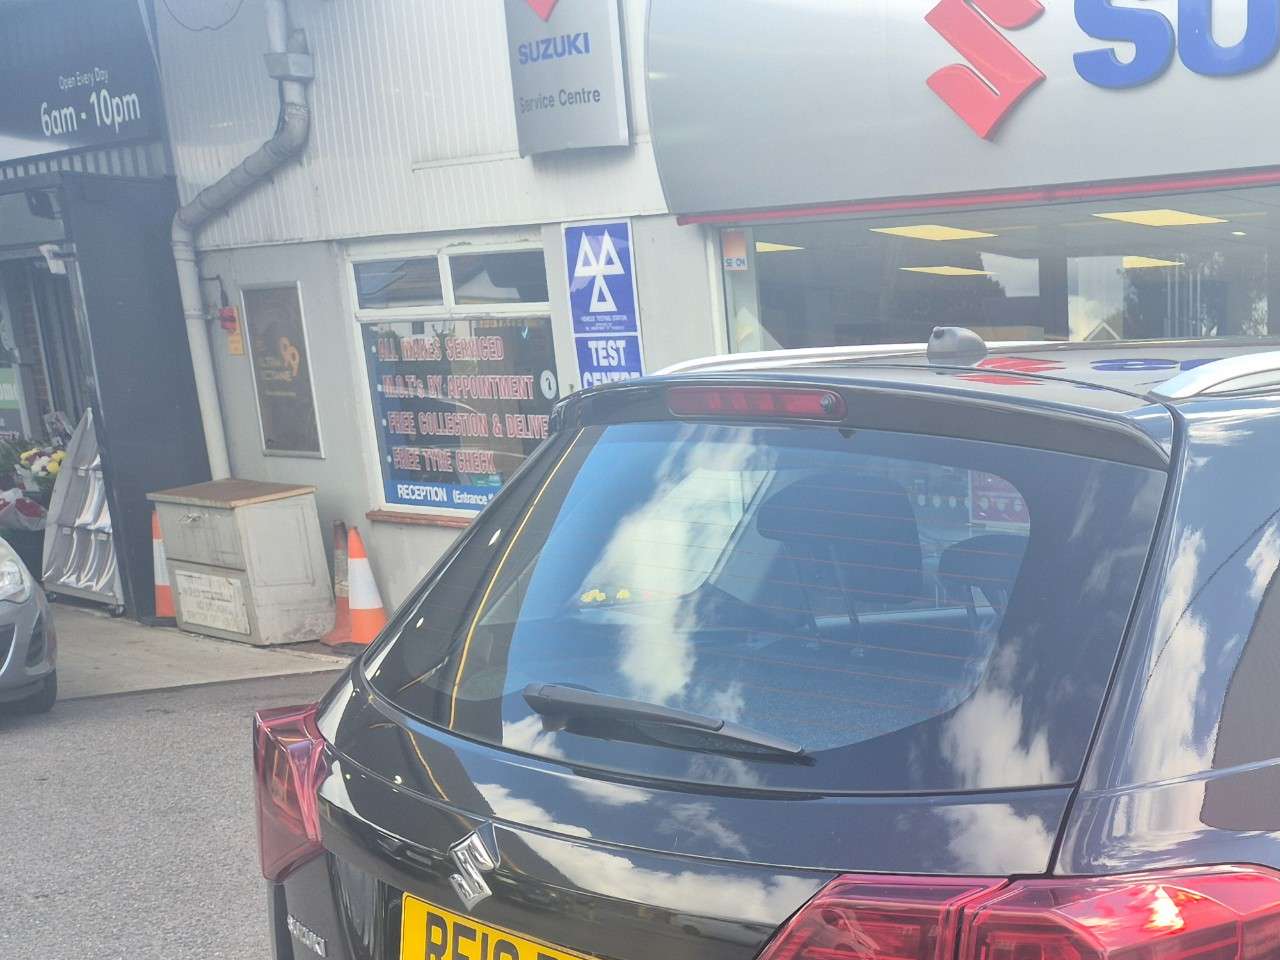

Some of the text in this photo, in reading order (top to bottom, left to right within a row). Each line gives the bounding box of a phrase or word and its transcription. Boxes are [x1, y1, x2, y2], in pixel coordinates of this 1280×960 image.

[518, 32, 590, 65] SUZUKI
[94, 67, 109, 83] Day
[41, 101, 77, 136] 6am
[90, 88, 141, 134] 10pm
[519, 87, 601, 114] Service Centre
[378, 336, 504, 361] ALL MAKES SERVICED
[588, 340, 626, 366] TEST
[427, 375, 443, 399] BY
[447, 375, 534, 400] APPOINTMENT
[387, 411, 550, 439] FREE COLLECTION & DELIVE
[393, 447, 497, 474] FREE TYRE CHECK
[397, 484, 448, 502] RECEPTION
